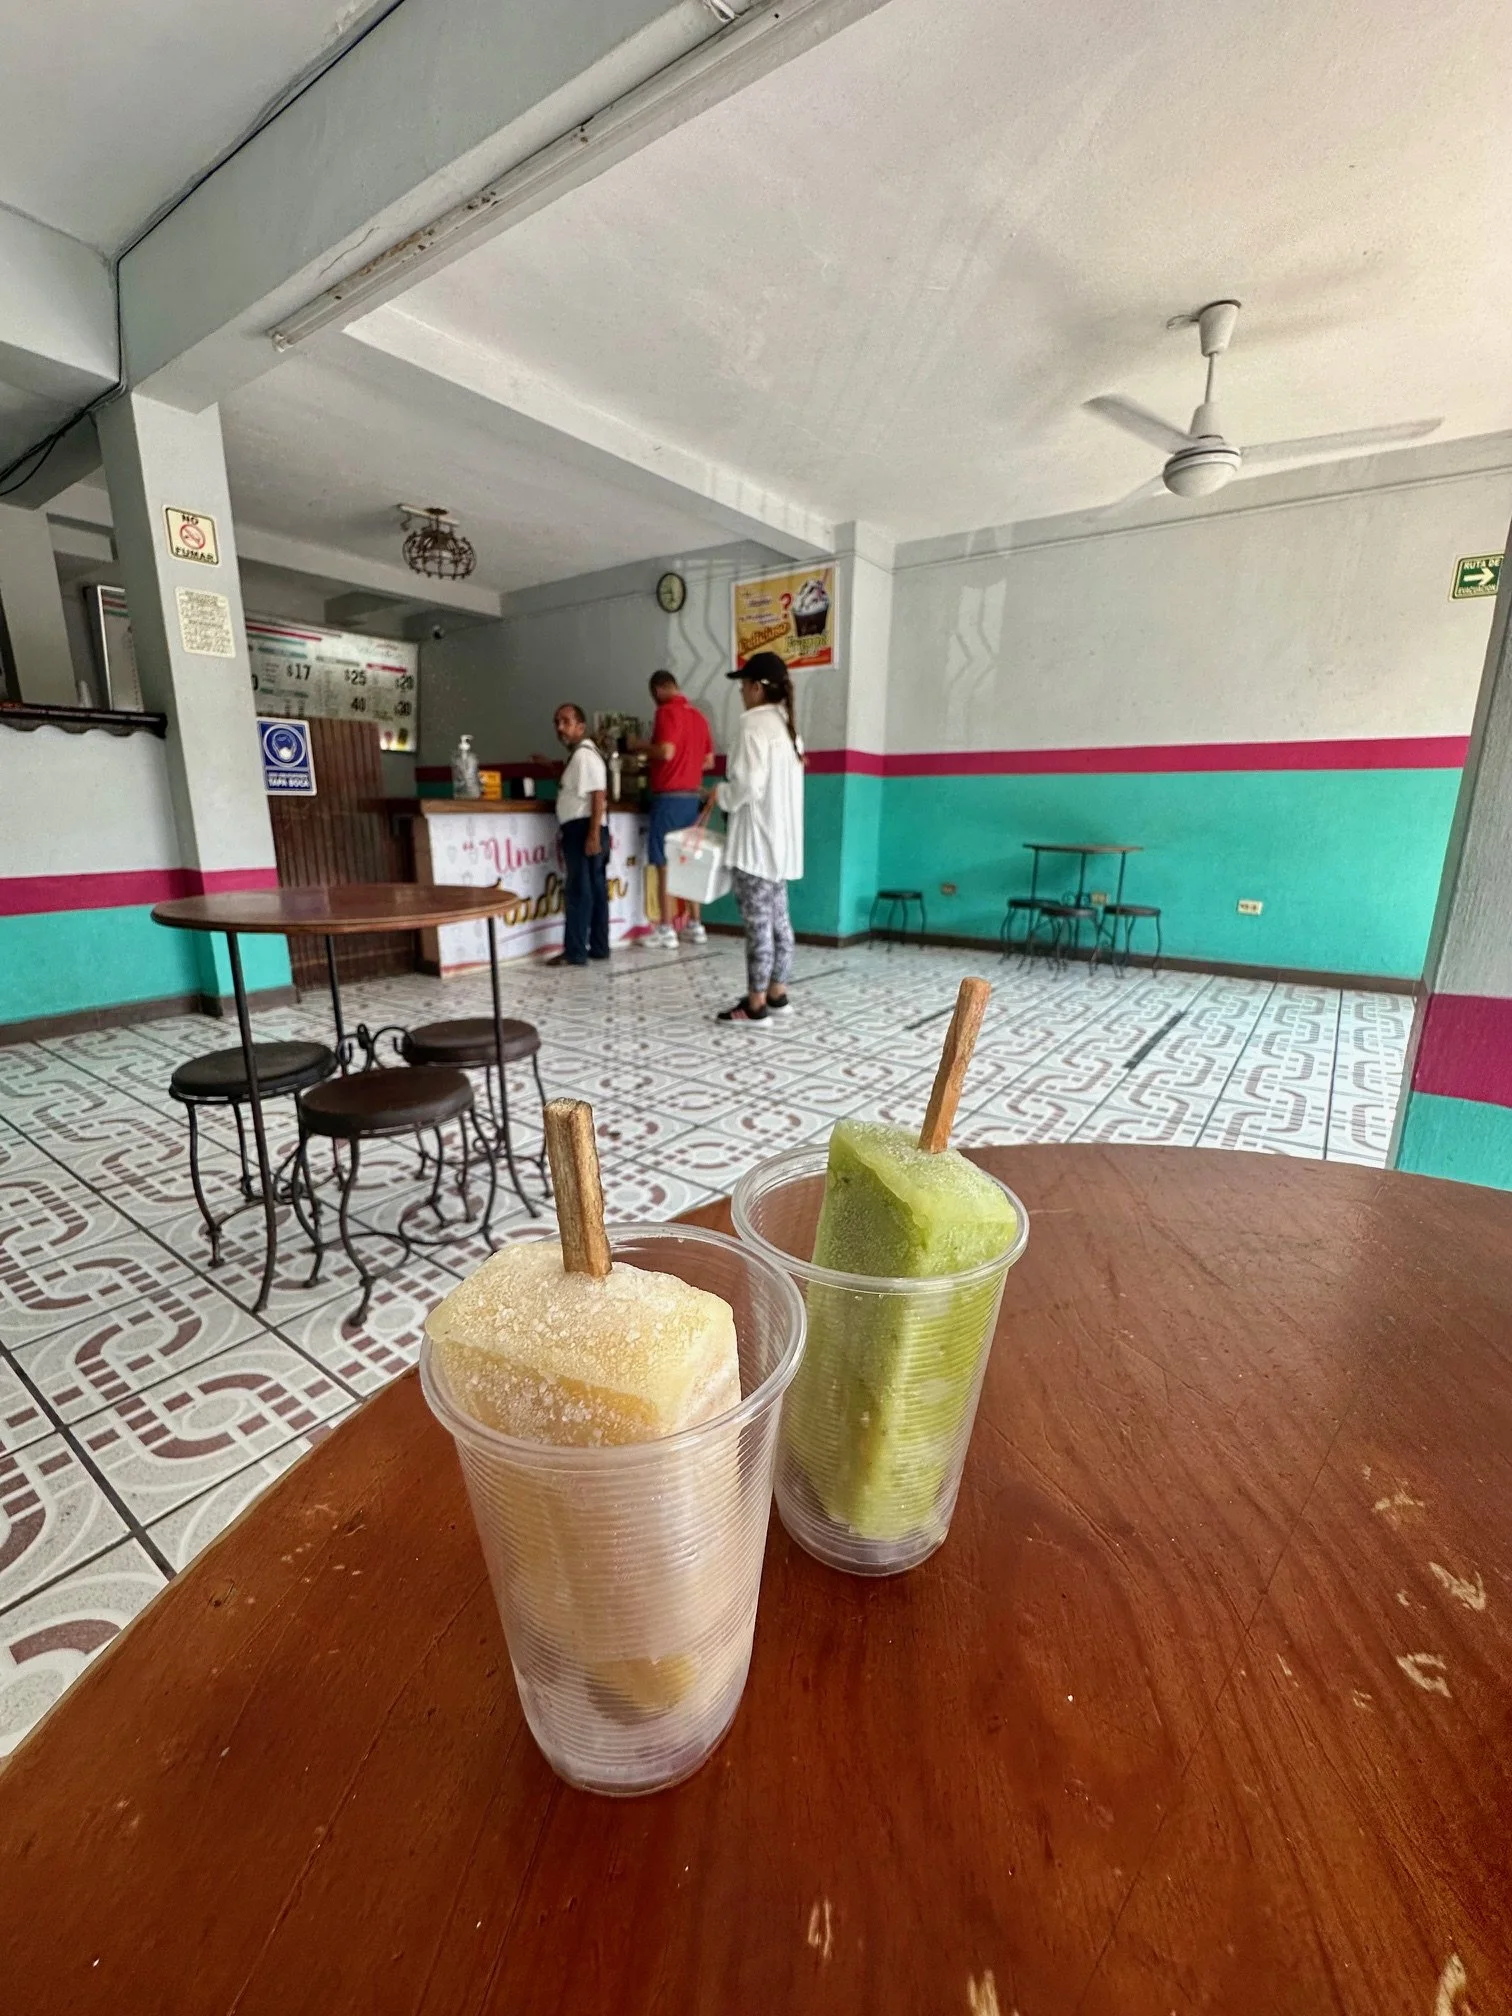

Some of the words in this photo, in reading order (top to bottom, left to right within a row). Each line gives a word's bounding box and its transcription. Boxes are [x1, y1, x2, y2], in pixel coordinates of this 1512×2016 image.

[181, 514, 199, 525] NO
[175, 546, 214, 563] FUMAR
[1463, 560, 1486, 570] RUTA
[286, 663, 311, 681] $17
[344, 669, 367, 686] $25
